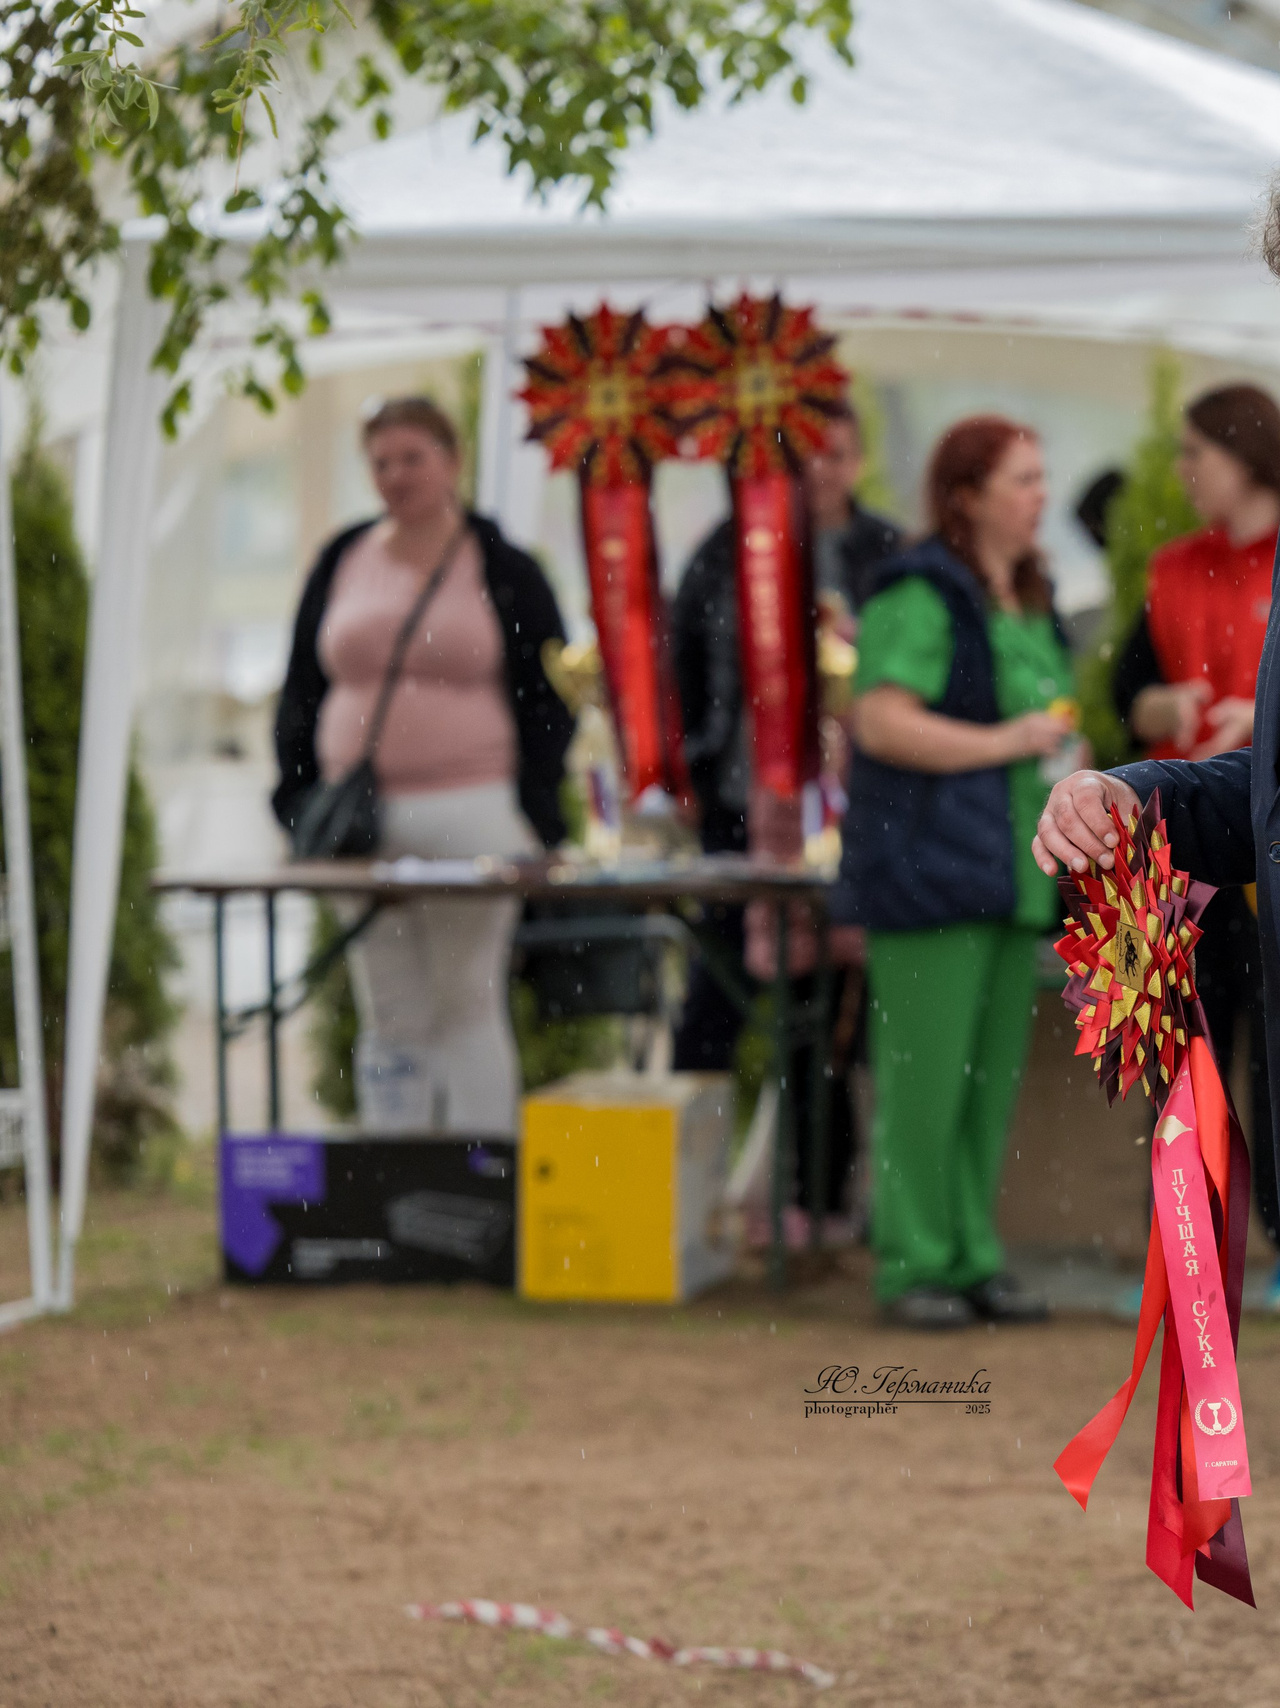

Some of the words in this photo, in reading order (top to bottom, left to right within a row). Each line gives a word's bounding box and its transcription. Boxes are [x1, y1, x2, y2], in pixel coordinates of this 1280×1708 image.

[1171, 1168, 1200, 1277] ЛУЧШАЯ
[1192, 1300, 1217, 1369] СУКА
[1211, 1460, 1238, 1468] САРАТОВ
